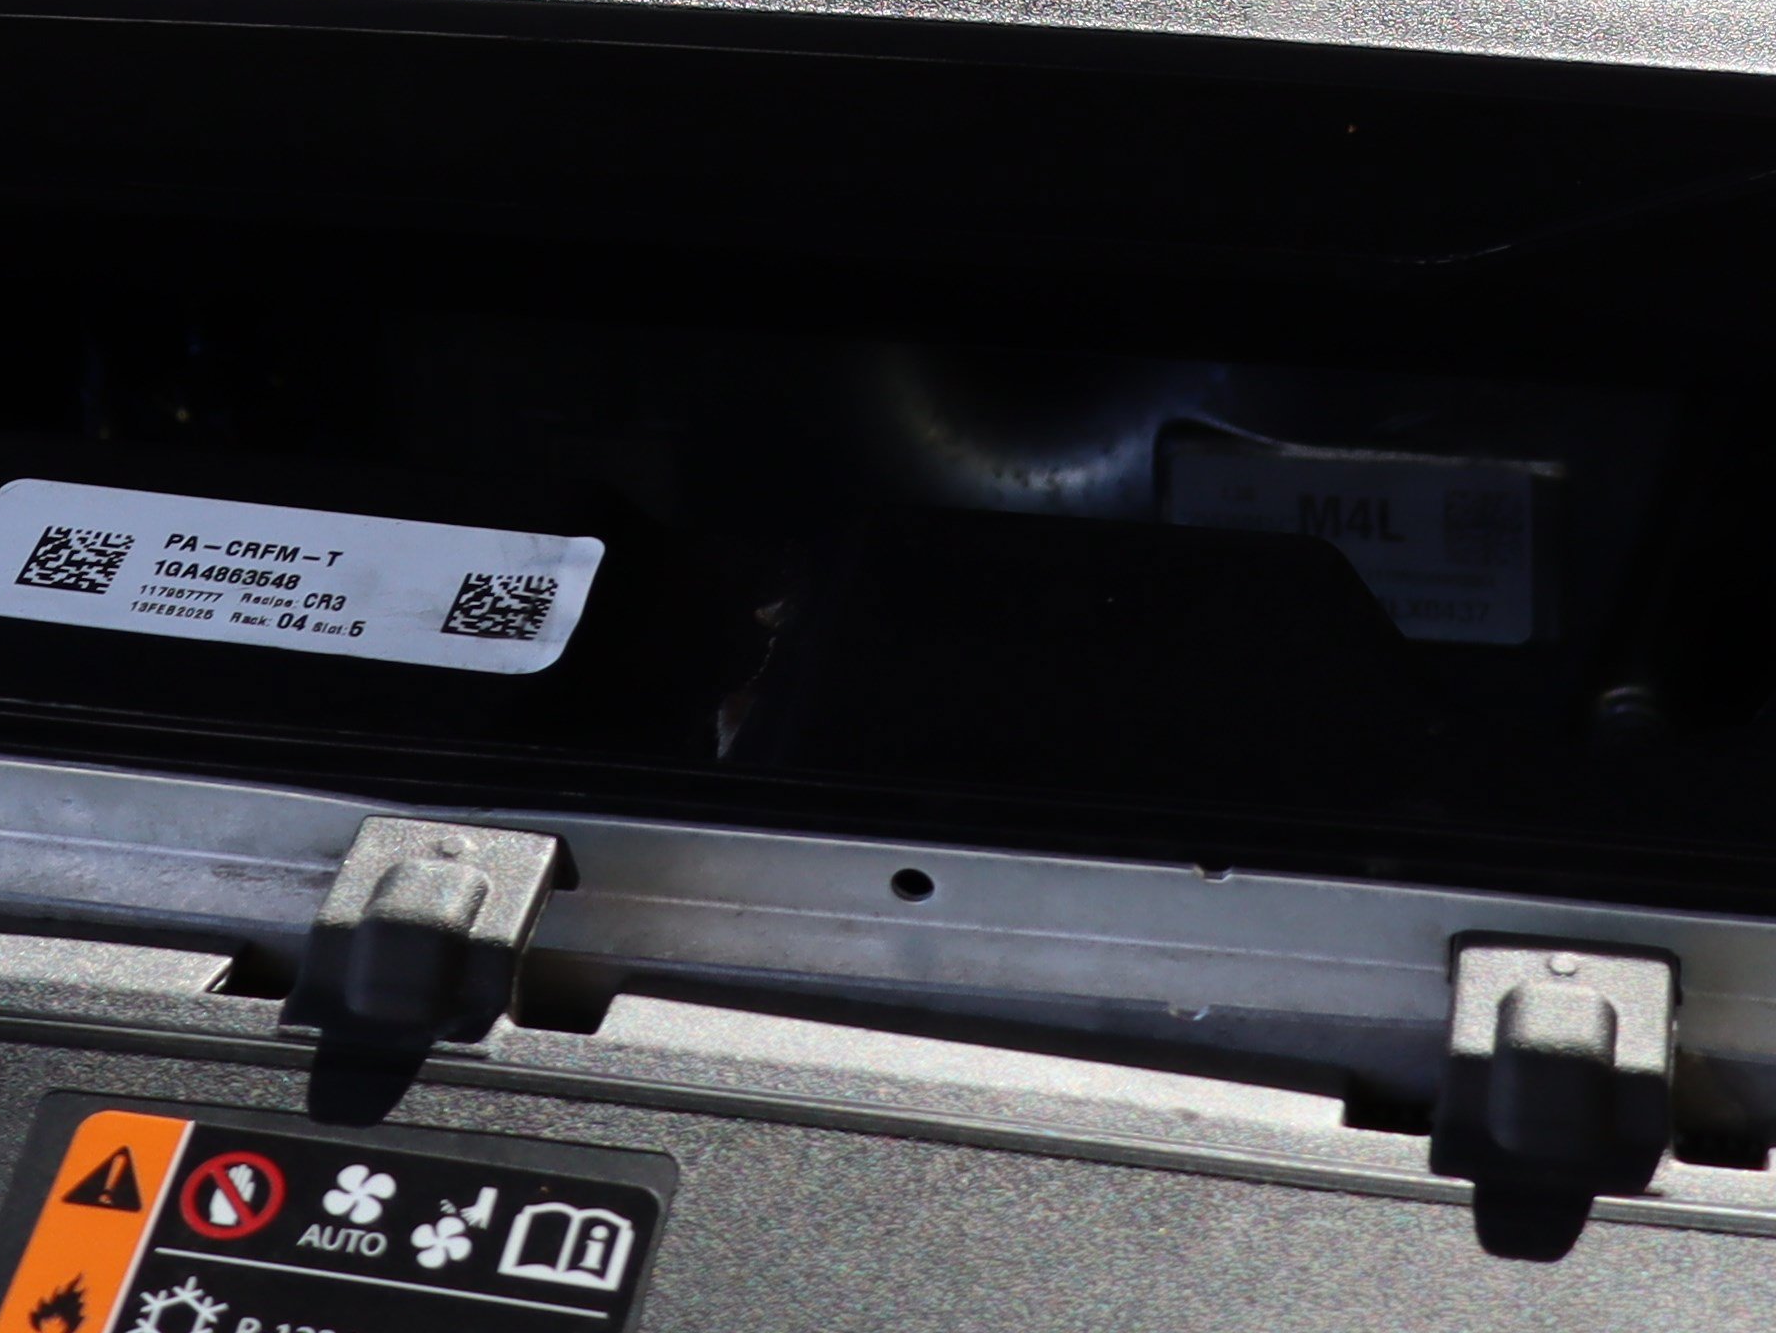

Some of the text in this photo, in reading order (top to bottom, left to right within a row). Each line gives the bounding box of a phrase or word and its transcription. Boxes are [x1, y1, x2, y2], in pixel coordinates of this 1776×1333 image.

[1297, 494, 1406, 543] M4L
[164, 534, 343, 566] PA-CRFM-T
[155, 560, 302, 590] 1GA4863548
[303, 592, 347, 611] CR3
[277, 612, 309, 631] 04
[296, 1223, 388, 1257] AUTO
